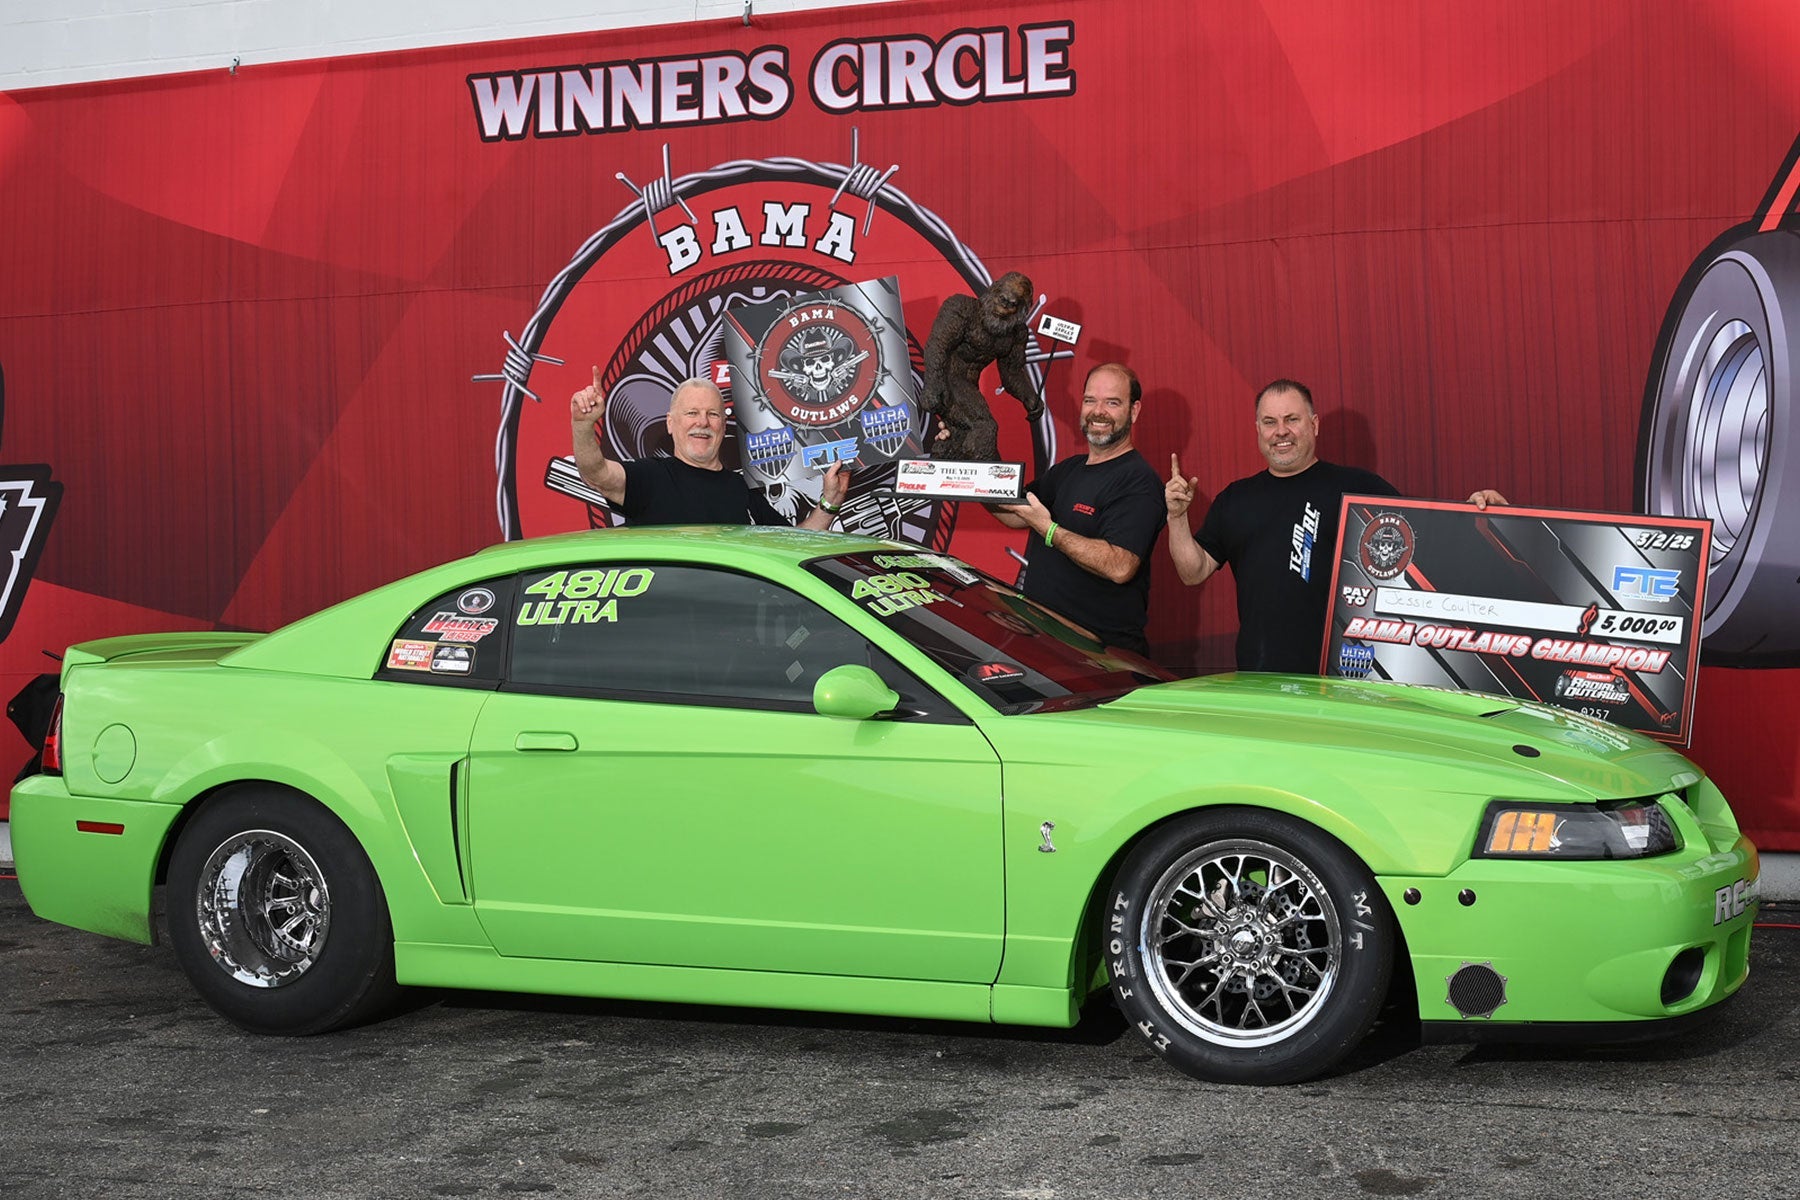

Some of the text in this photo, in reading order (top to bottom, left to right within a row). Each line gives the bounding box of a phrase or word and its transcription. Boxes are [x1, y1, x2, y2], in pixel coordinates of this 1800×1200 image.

[470, 25, 1072, 138] WINNERS CIRCLE
[659, 201, 857, 275] BAMA
[788, 308, 835, 328] BAMA
[790, 394, 859, 421] OUTLAWS
[864, 407, 907, 426] ULTRA
[748, 430, 791, 449] ULTRA
[802, 437, 860, 468] FTE
[940, 467, 957, 475] THE
[959, 467, 978, 476] YETI
[1379, 517, 1401, 526] BAMA
[1289, 522, 1305, 574] TEAM
[1636, 532, 1694, 550] 3/2/25
[1367, 564, 1399, 578] OUTLAWS
[1612, 565, 1681, 597] FTE
[524, 568, 655, 600] 4810
[851, 571, 931, 600] 4810
[1342, 585, 1371, 598] PAY
[867, 588, 946, 617] ULTRA
[1346, 595, 1366, 606] TO
[1384, 590, 1432, 609] Jessie
[516, 599, 618, 626] ULTRA
[1342, 647, 1371, 659] ULTRA
[1343, 617, 1670, 673] BAMA OUTLAWS CHAMPION
[1563, 686, 1631, 702] OUTLAWS
[1570, 677, 1616, 692] RADIAL
[1110, 890, 1134, 1000] FRONT
[1137, 1019, 1172, 1053] ET
